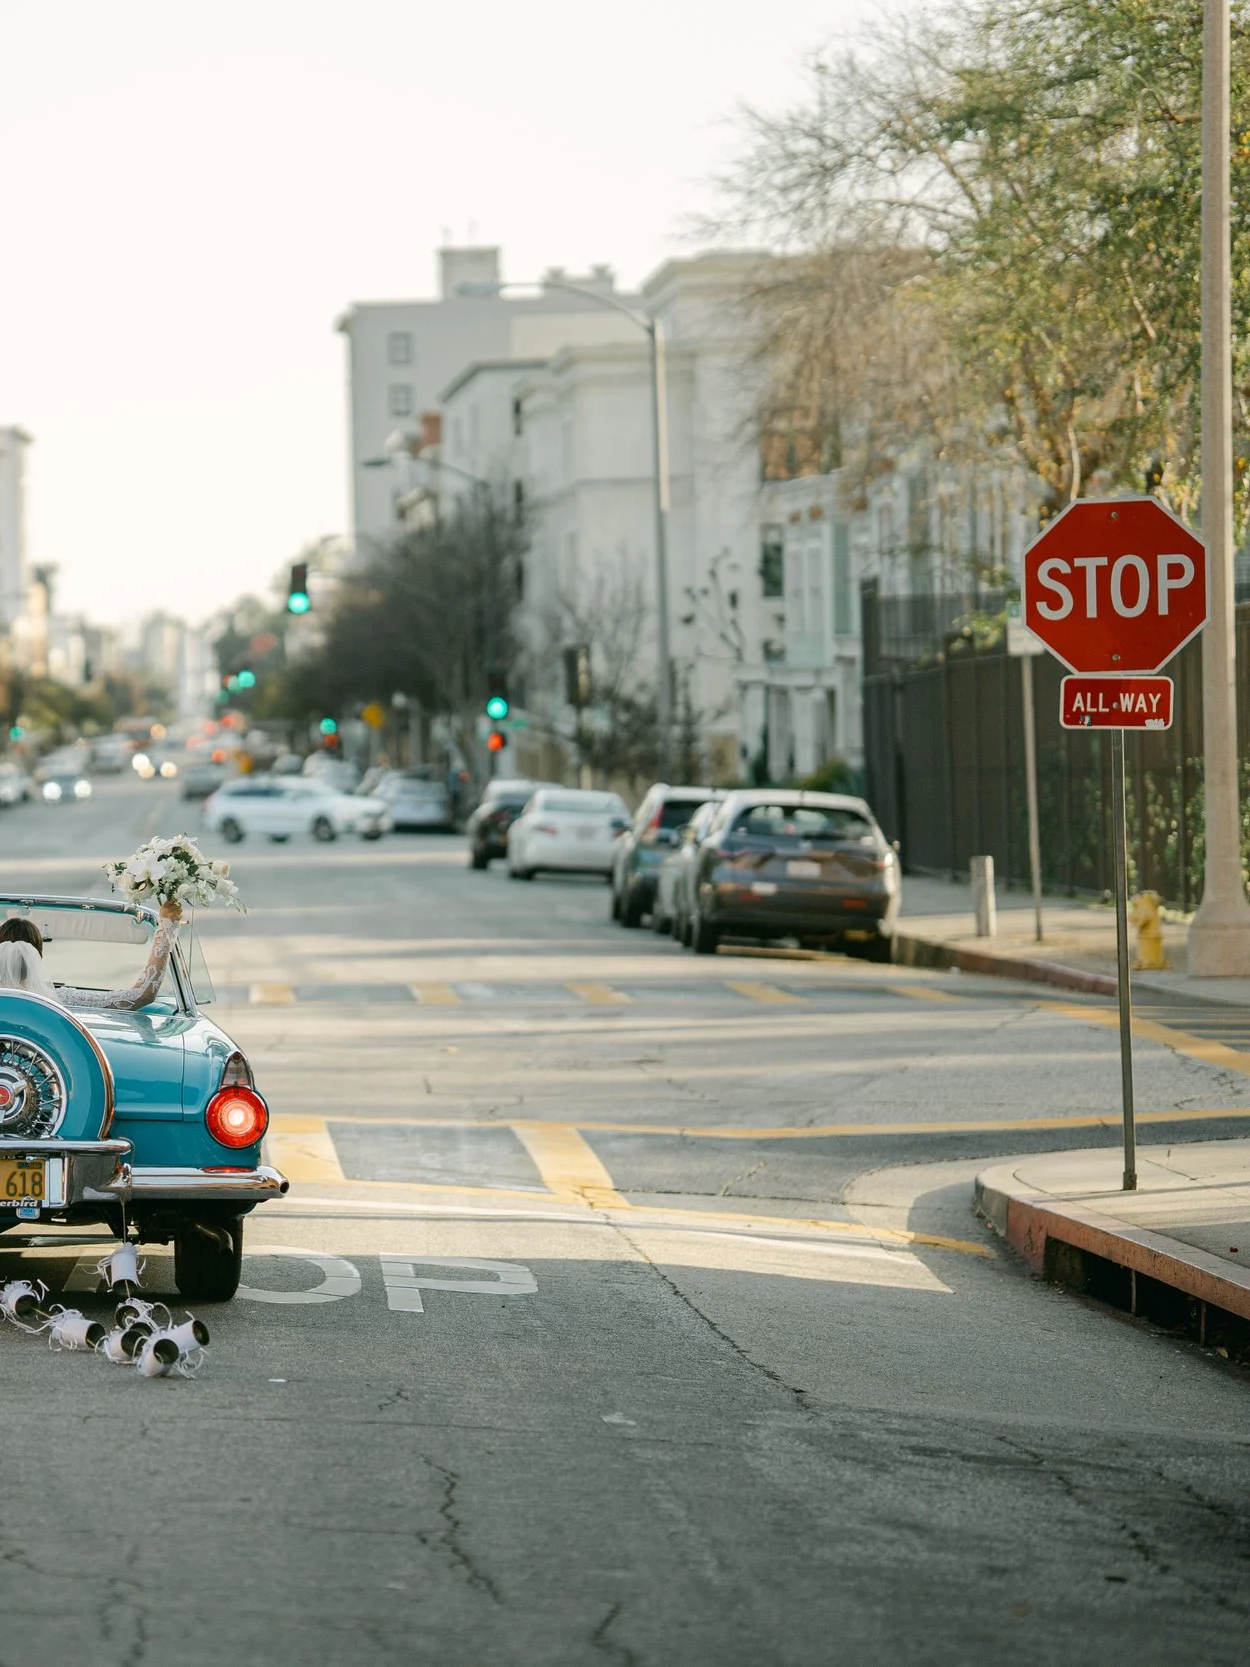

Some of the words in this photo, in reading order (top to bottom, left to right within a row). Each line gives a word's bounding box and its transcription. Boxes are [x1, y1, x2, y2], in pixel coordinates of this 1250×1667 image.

[1036, 553, 1195, 621] STOP
[1072, 692, 1109, 713] ALL
[1119, 692, 1161, 713] WAY
[6, 1171, 42, 1196] 618
